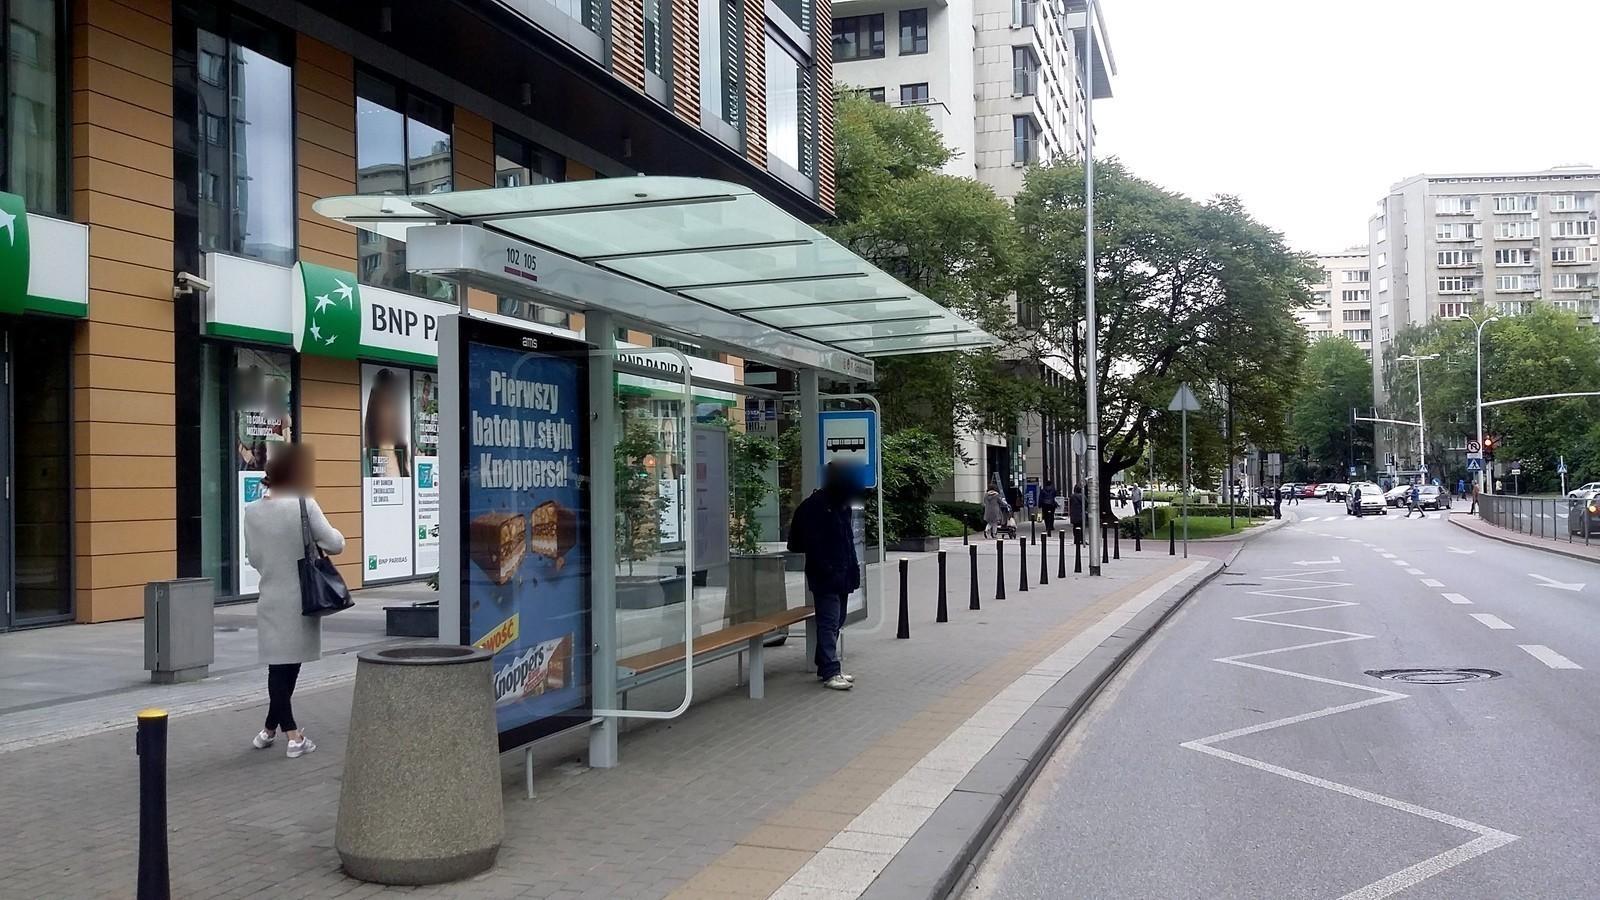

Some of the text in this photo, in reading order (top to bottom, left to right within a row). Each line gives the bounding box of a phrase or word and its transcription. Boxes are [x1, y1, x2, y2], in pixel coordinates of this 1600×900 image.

[506, 247, 537, 271] 102 105
[371, 303, 418, 337] BNP
[522, 336, 538, 349] ams
[490, 370, 559, 414] Pierwszy
[472, 410, 573, 452] baton w stylu
[480, 452, 568, 491] Knoppersa!
